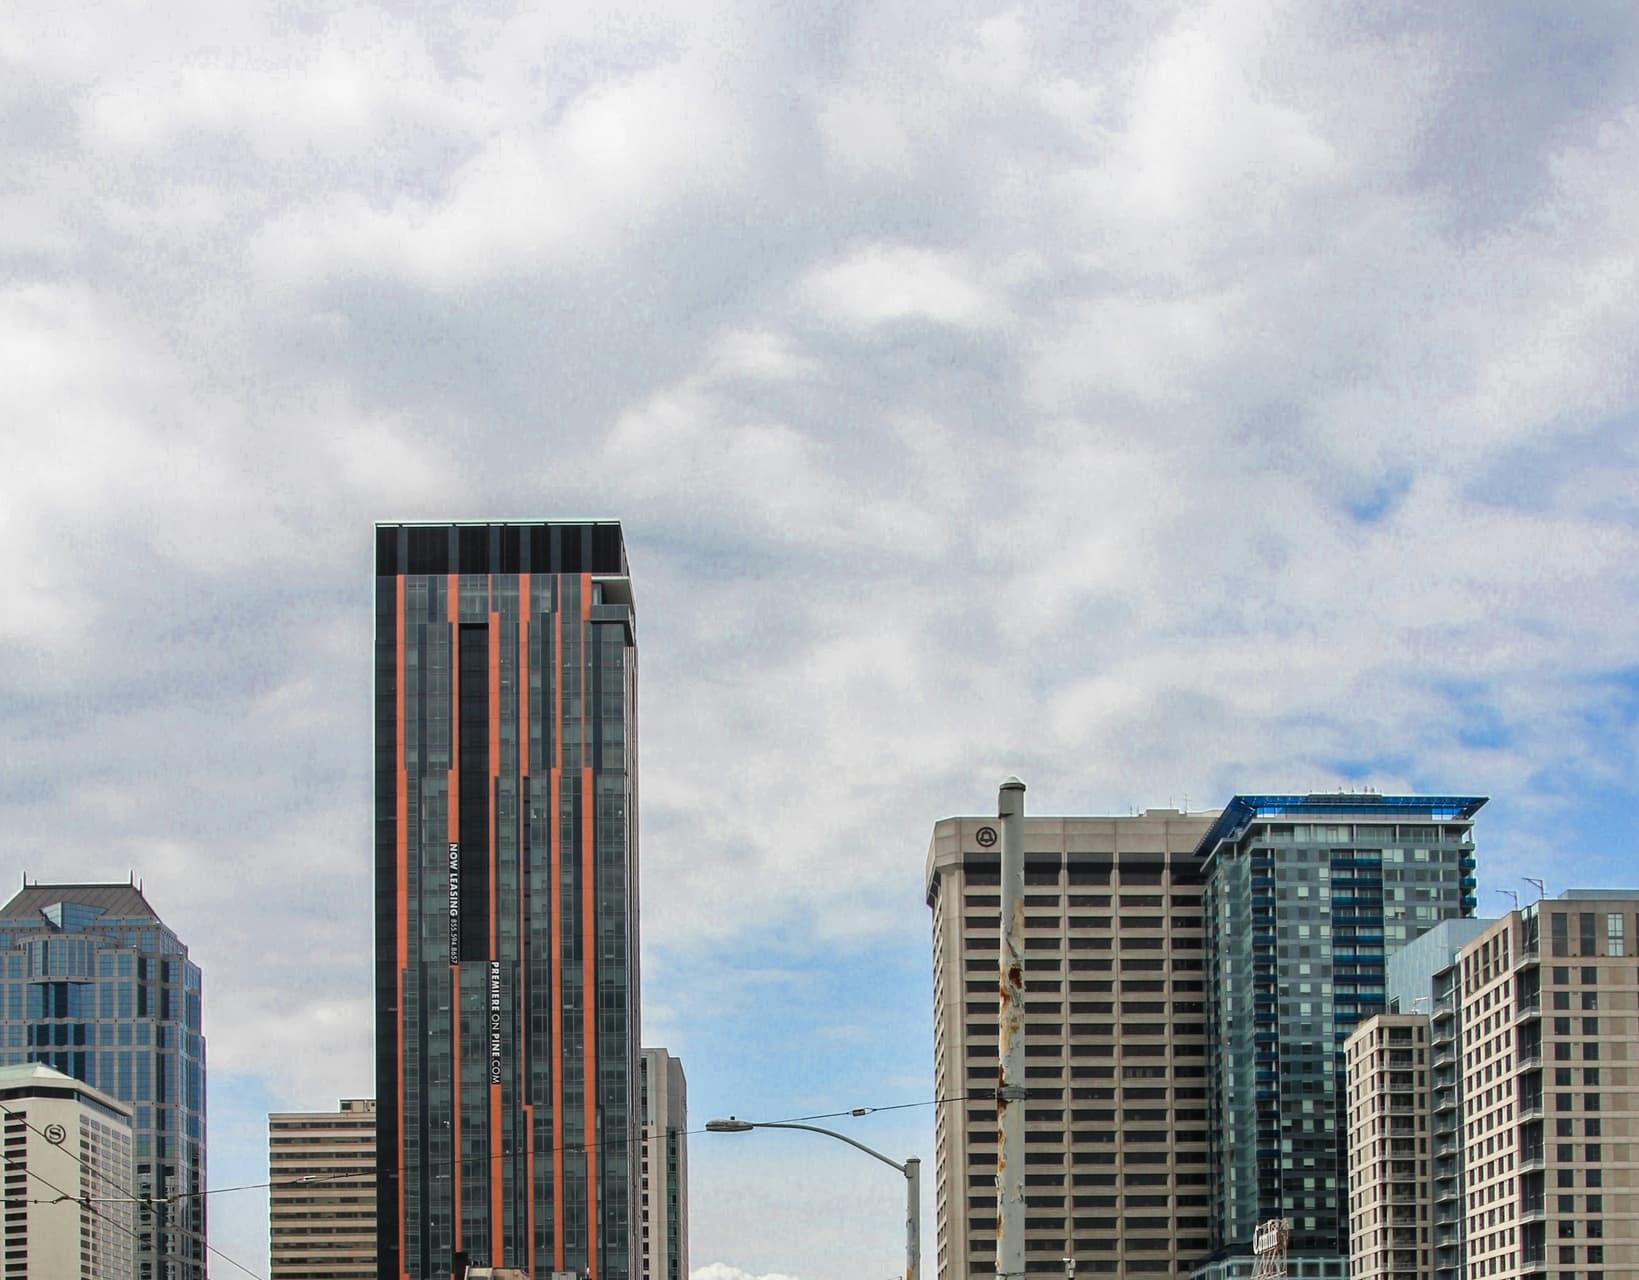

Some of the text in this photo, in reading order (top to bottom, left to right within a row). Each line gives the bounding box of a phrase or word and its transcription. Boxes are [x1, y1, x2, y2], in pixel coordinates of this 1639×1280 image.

[449, 843, 458, 870] NOW
[449, 873, 458, 917] LEASING
[491, 961, 501, 1084] PREMIERE ON PINE.COM
